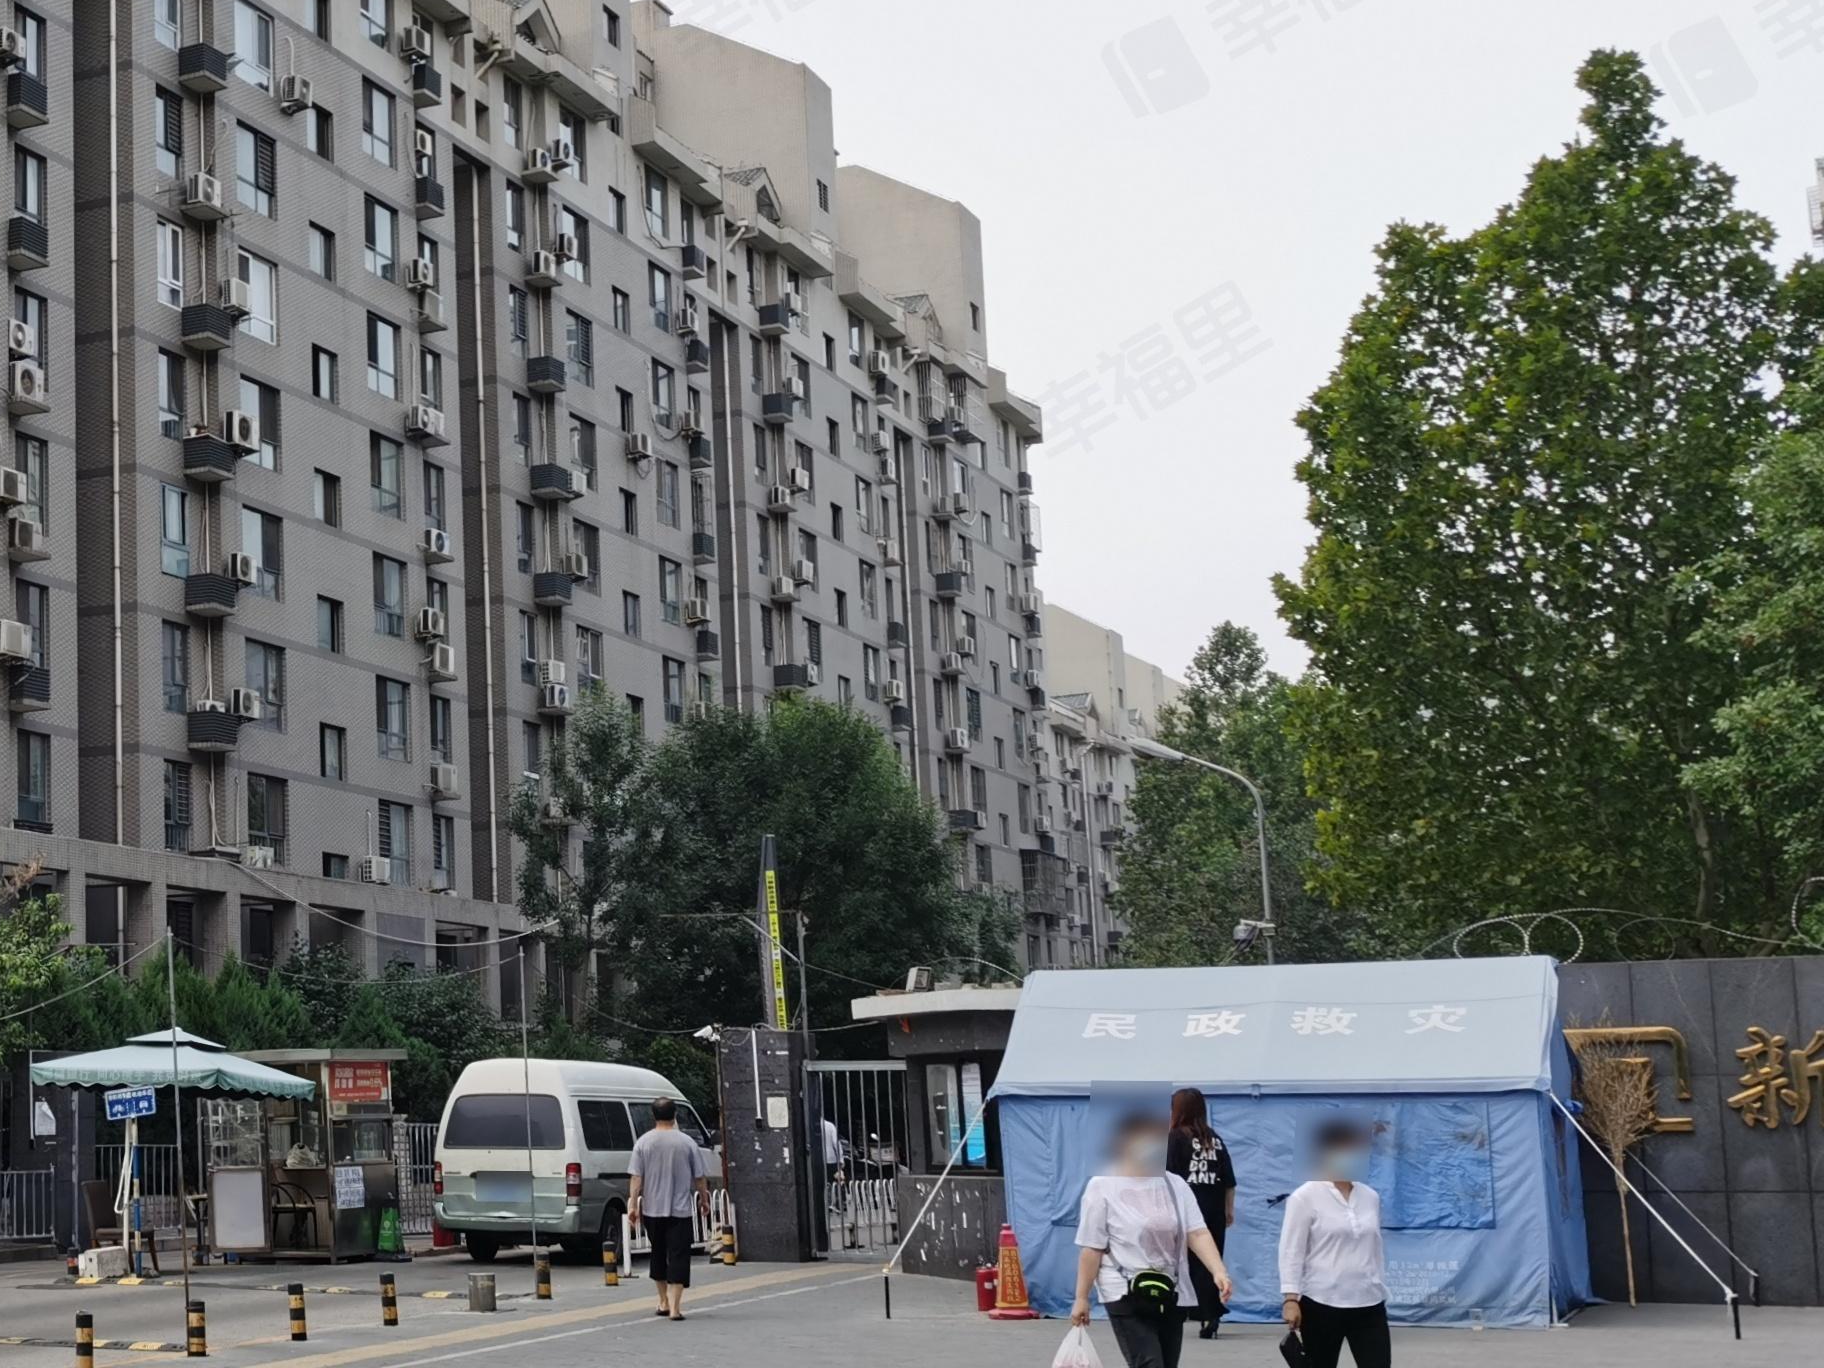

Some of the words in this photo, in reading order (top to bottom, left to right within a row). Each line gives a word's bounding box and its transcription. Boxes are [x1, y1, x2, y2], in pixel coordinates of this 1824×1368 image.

[1081, 1004, 1467, 1039] 民政救灾
[1728, 1026, 1824, 1129] 新
[1192, 1149, 1218, 1161] CAN
[1189, 1160, 1208, 1171] DO
[1187, 1172, 1221, 1184] ANY-
